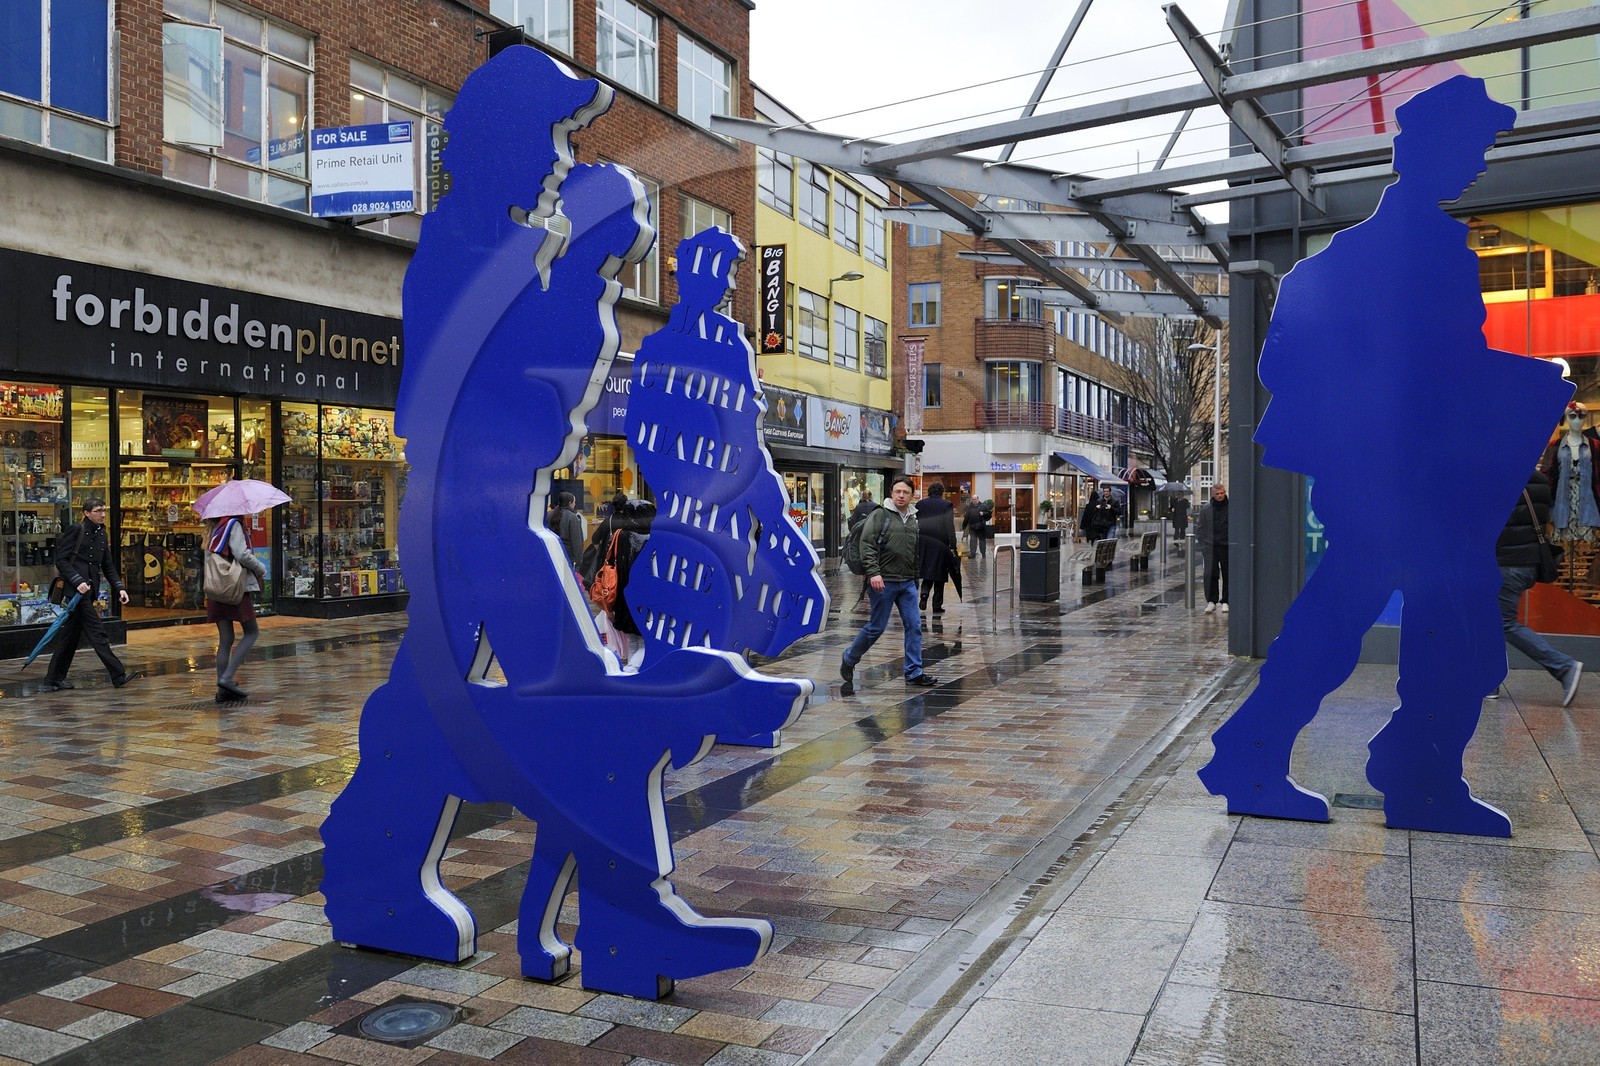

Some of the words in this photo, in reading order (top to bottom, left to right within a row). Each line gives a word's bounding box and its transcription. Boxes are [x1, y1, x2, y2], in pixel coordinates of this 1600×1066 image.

[316, 134, 337, 145] FOR
[340, 131, 367, 142] SALE
[316, 157, 346, 170] Prime
[349, 155, 378, 167] Retail
[382, 153, 402, 164] Unit
[352, 203, 368, 212] 028
[370, 201, 390, 211] 9024
[392, 200, 412, 209] 1500
[763, 247, 784, 258] BIG
[110, 342, 360, 391] international
[908, 344, 918, 405] DOORSTEPS
[824, 409, 852, 436] BANG!
[990, 461, 1007, 470] the
